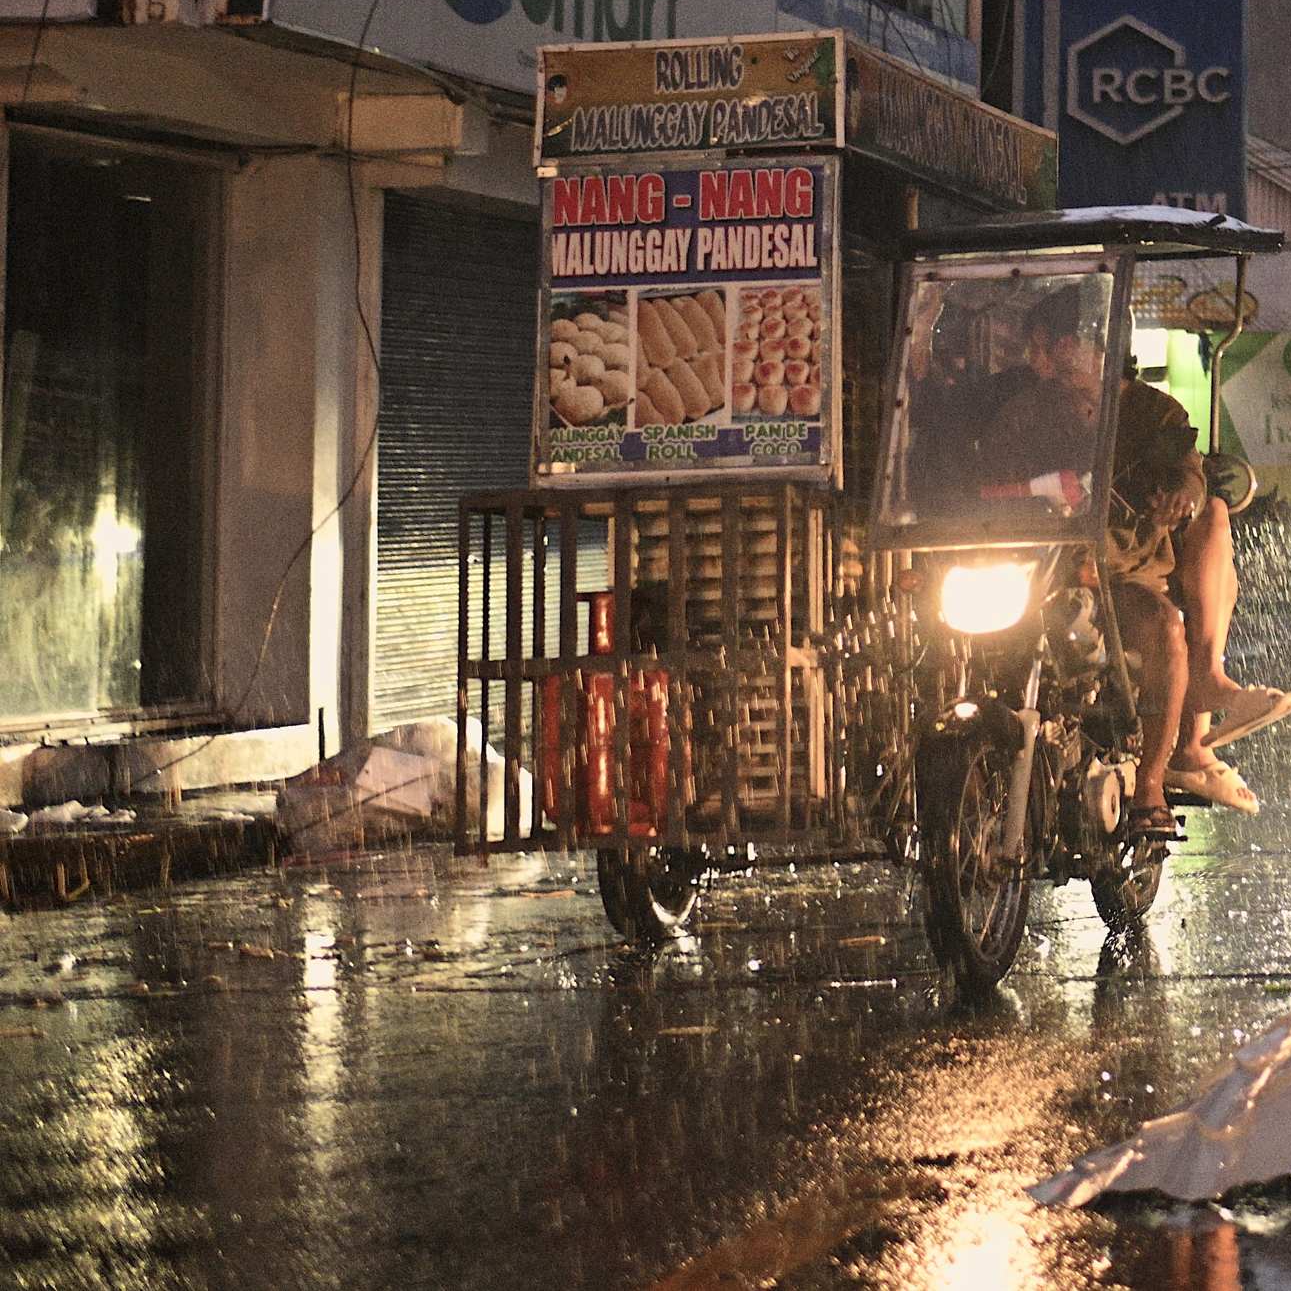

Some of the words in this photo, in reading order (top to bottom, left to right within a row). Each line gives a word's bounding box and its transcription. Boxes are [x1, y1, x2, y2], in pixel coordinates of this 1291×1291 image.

[654, 44, 745, 94] ROLLING
[1091, 66, 1232, 105] RCBC
[571, 100, 708, 152] MALUNGGAY
[710, 91, 825, 145] PANDESAL
[553, 173, 666, 227] NANG
[699, 167, 814, 220] NANG
[1153, 192, 1227, 213] ATM
[552, 227, 692, 276] MALUNGGAY
[696, 224, 818, 271] PANDESAL
[550, 426, 627, 444] ALUNGGAY
[642, 424, 718, 442] SPANISH
[744, 424, 782, 440] PAN
[783, 423, 808, 439] DE
[551, 445, 623, 463] ANDESAL
[646, 443, 698, 460] ROLL
[751, 441, 802, 456] COCO
